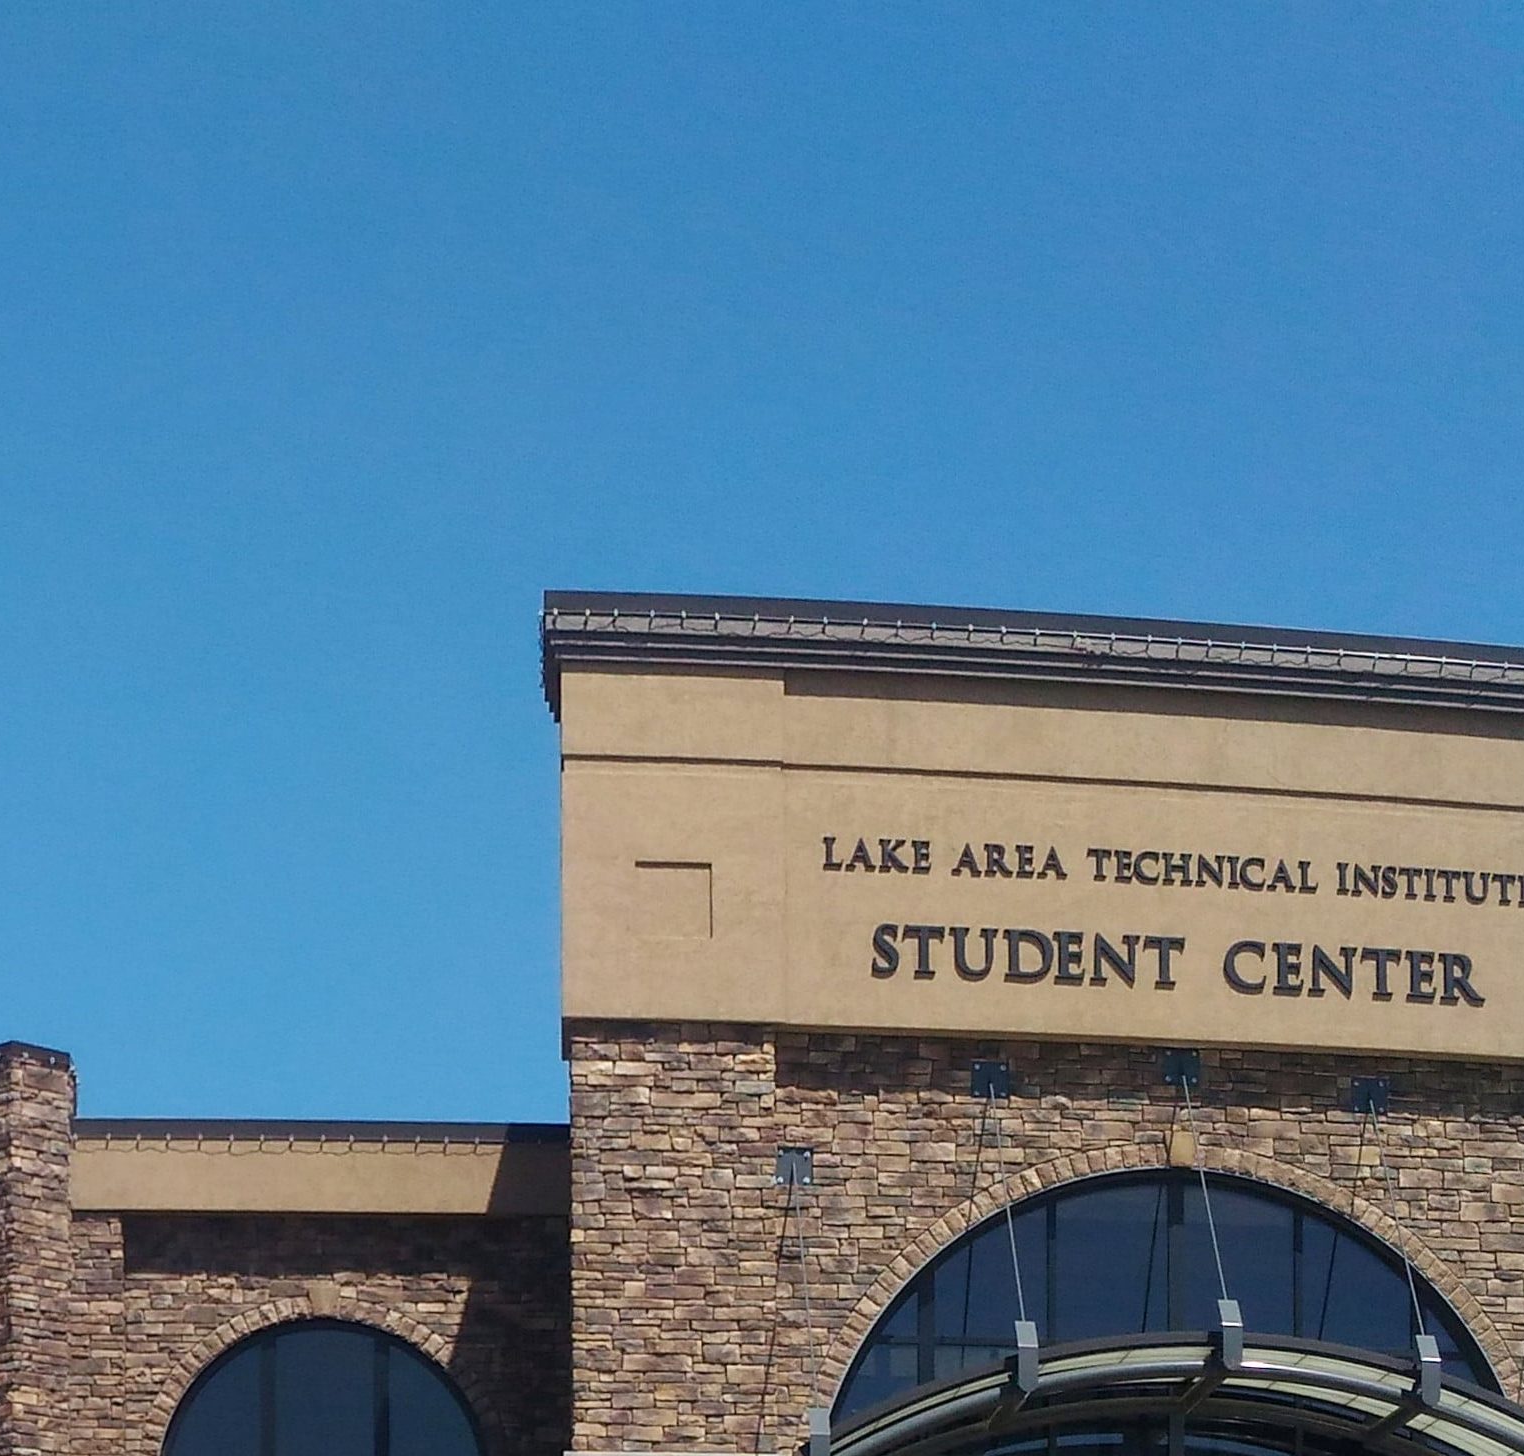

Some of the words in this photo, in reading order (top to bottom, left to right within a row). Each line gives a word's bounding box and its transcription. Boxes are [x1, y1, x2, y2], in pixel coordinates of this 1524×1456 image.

[822, 836, 932, 875] LAKE
[951, 843, 1068, 881] AREA
[1086, 847, 1319, 895] TECHNICAL
[871, 923, 1186, 991] STUDENT
[1222, 940, 1486, 1008] CENTER
